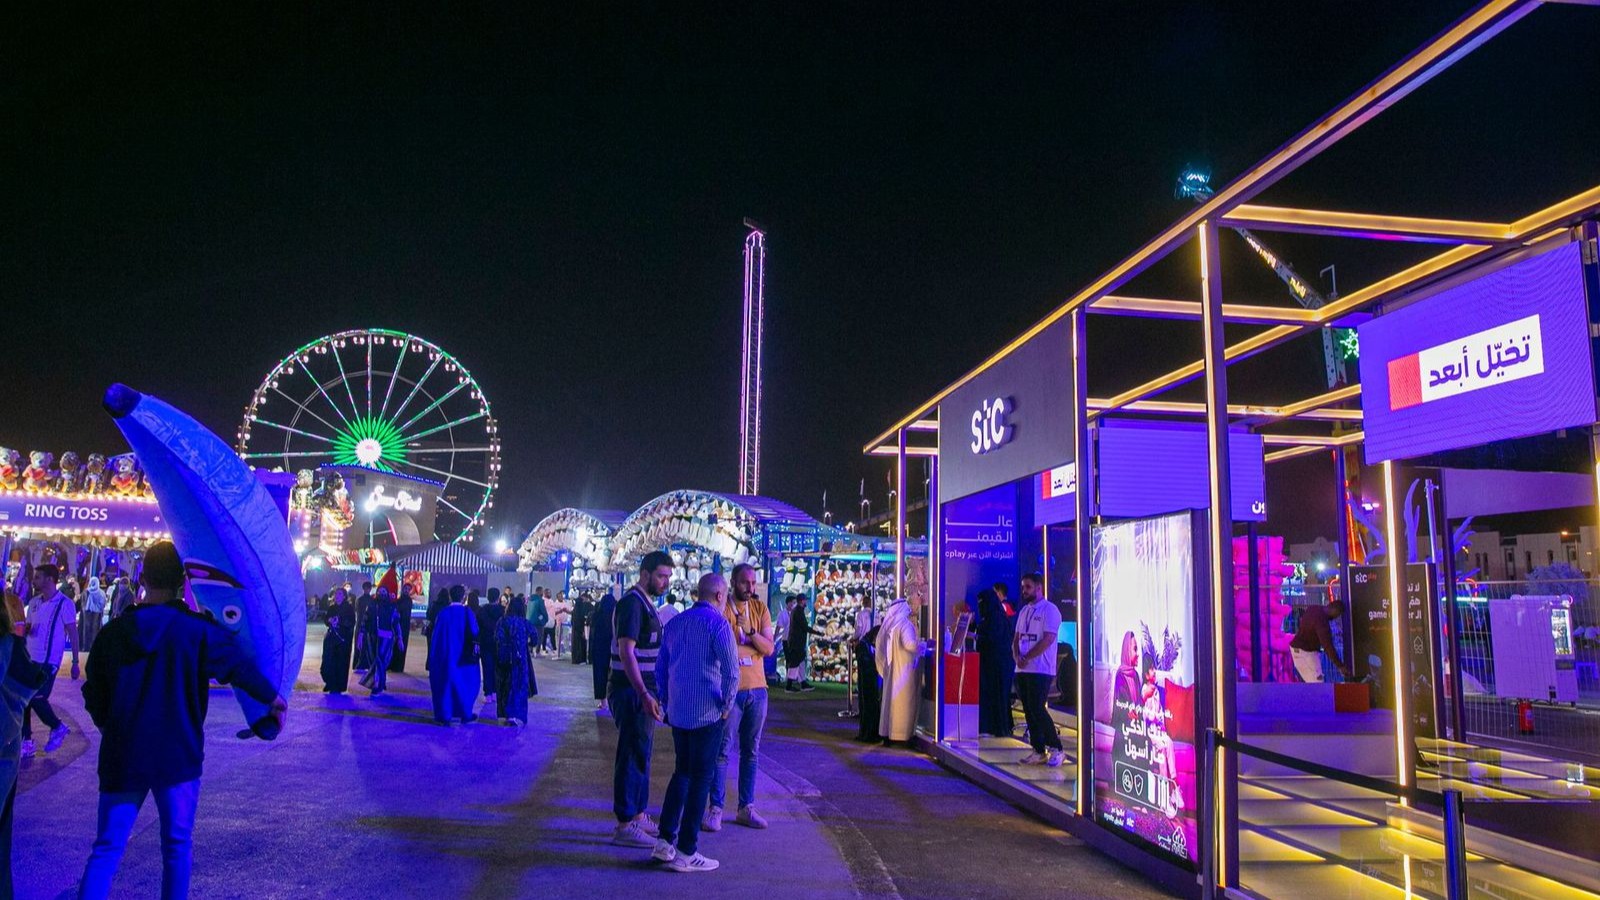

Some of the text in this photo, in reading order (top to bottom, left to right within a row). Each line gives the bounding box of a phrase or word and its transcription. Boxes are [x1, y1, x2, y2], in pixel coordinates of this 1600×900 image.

[1429, 346, 1469, 388] أبعد
[971, 397, 1005, 454] stc
[24, 503, 109, 521] RING TOSS
[1355, 572, 1368, 583] stc
[1368, 610, 1388, 621] game
[1122, 718, 1147, 740] الذكي
[1124, 739, 1149, 760] أسهل
